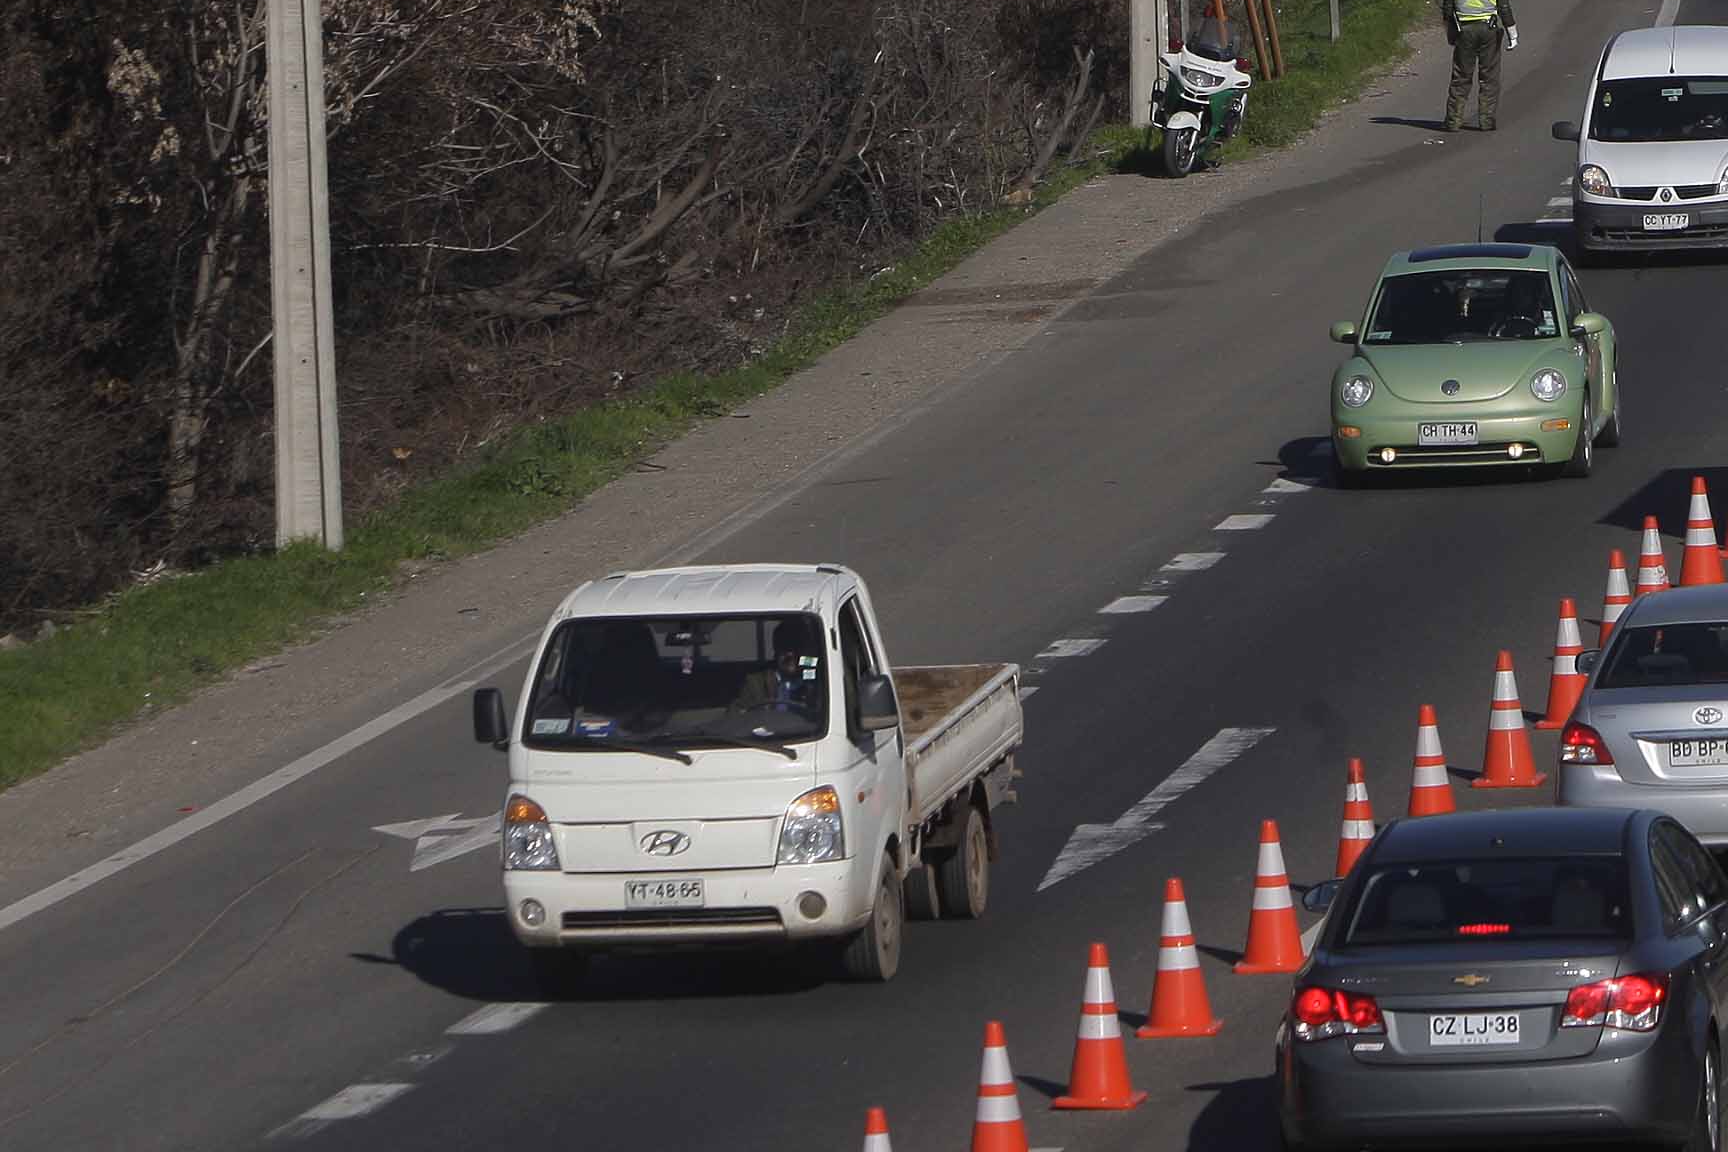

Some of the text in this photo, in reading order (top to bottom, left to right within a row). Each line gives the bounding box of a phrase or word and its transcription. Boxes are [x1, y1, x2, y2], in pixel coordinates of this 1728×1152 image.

[1423, 425, 1437, 437] CH
[1672, 741, 1692, 758] BD
[1432, 1017, 1457, 1036] CZ
